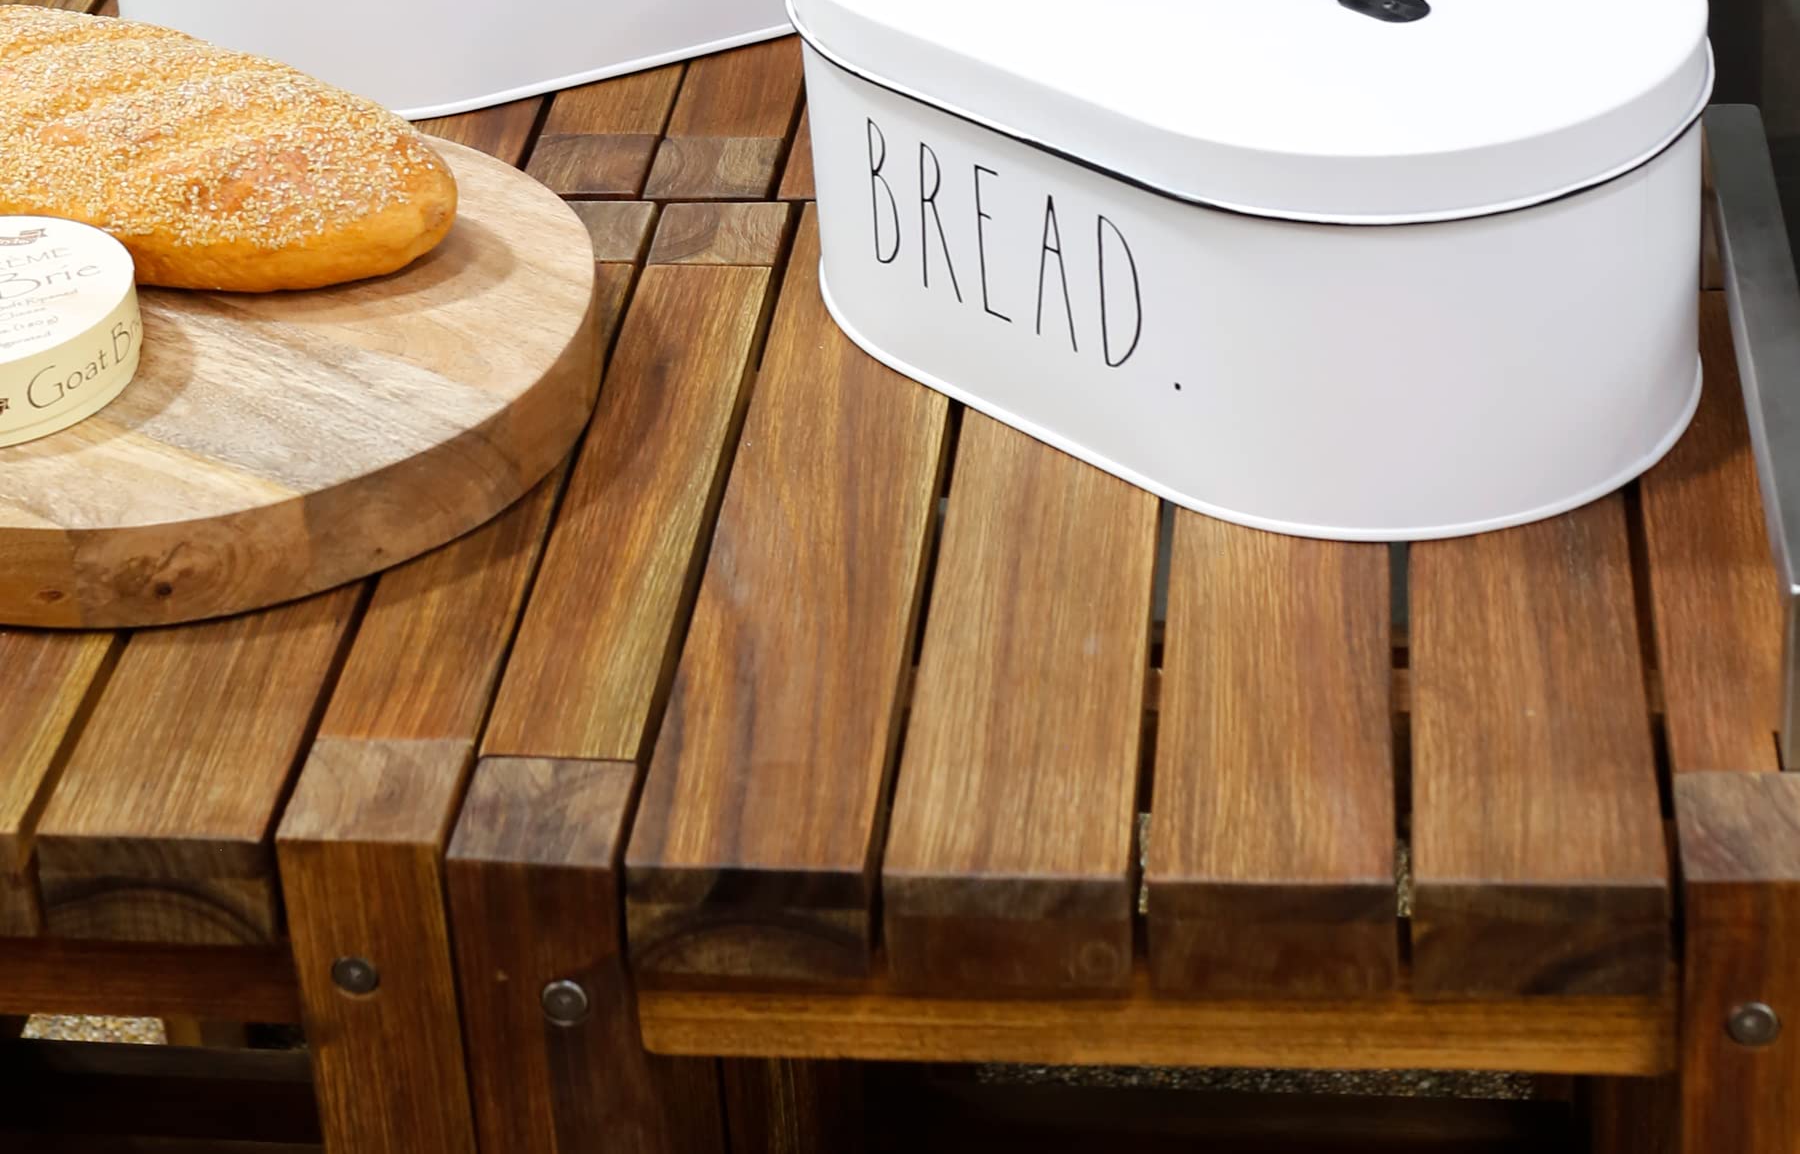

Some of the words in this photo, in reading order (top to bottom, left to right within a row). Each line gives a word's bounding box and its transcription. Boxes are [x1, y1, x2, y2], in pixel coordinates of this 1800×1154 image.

[0, 247, 73, 271] ÈME
[867, 117, 1182, 392] BREAD.
[26, 349, 109, 409] Goat
